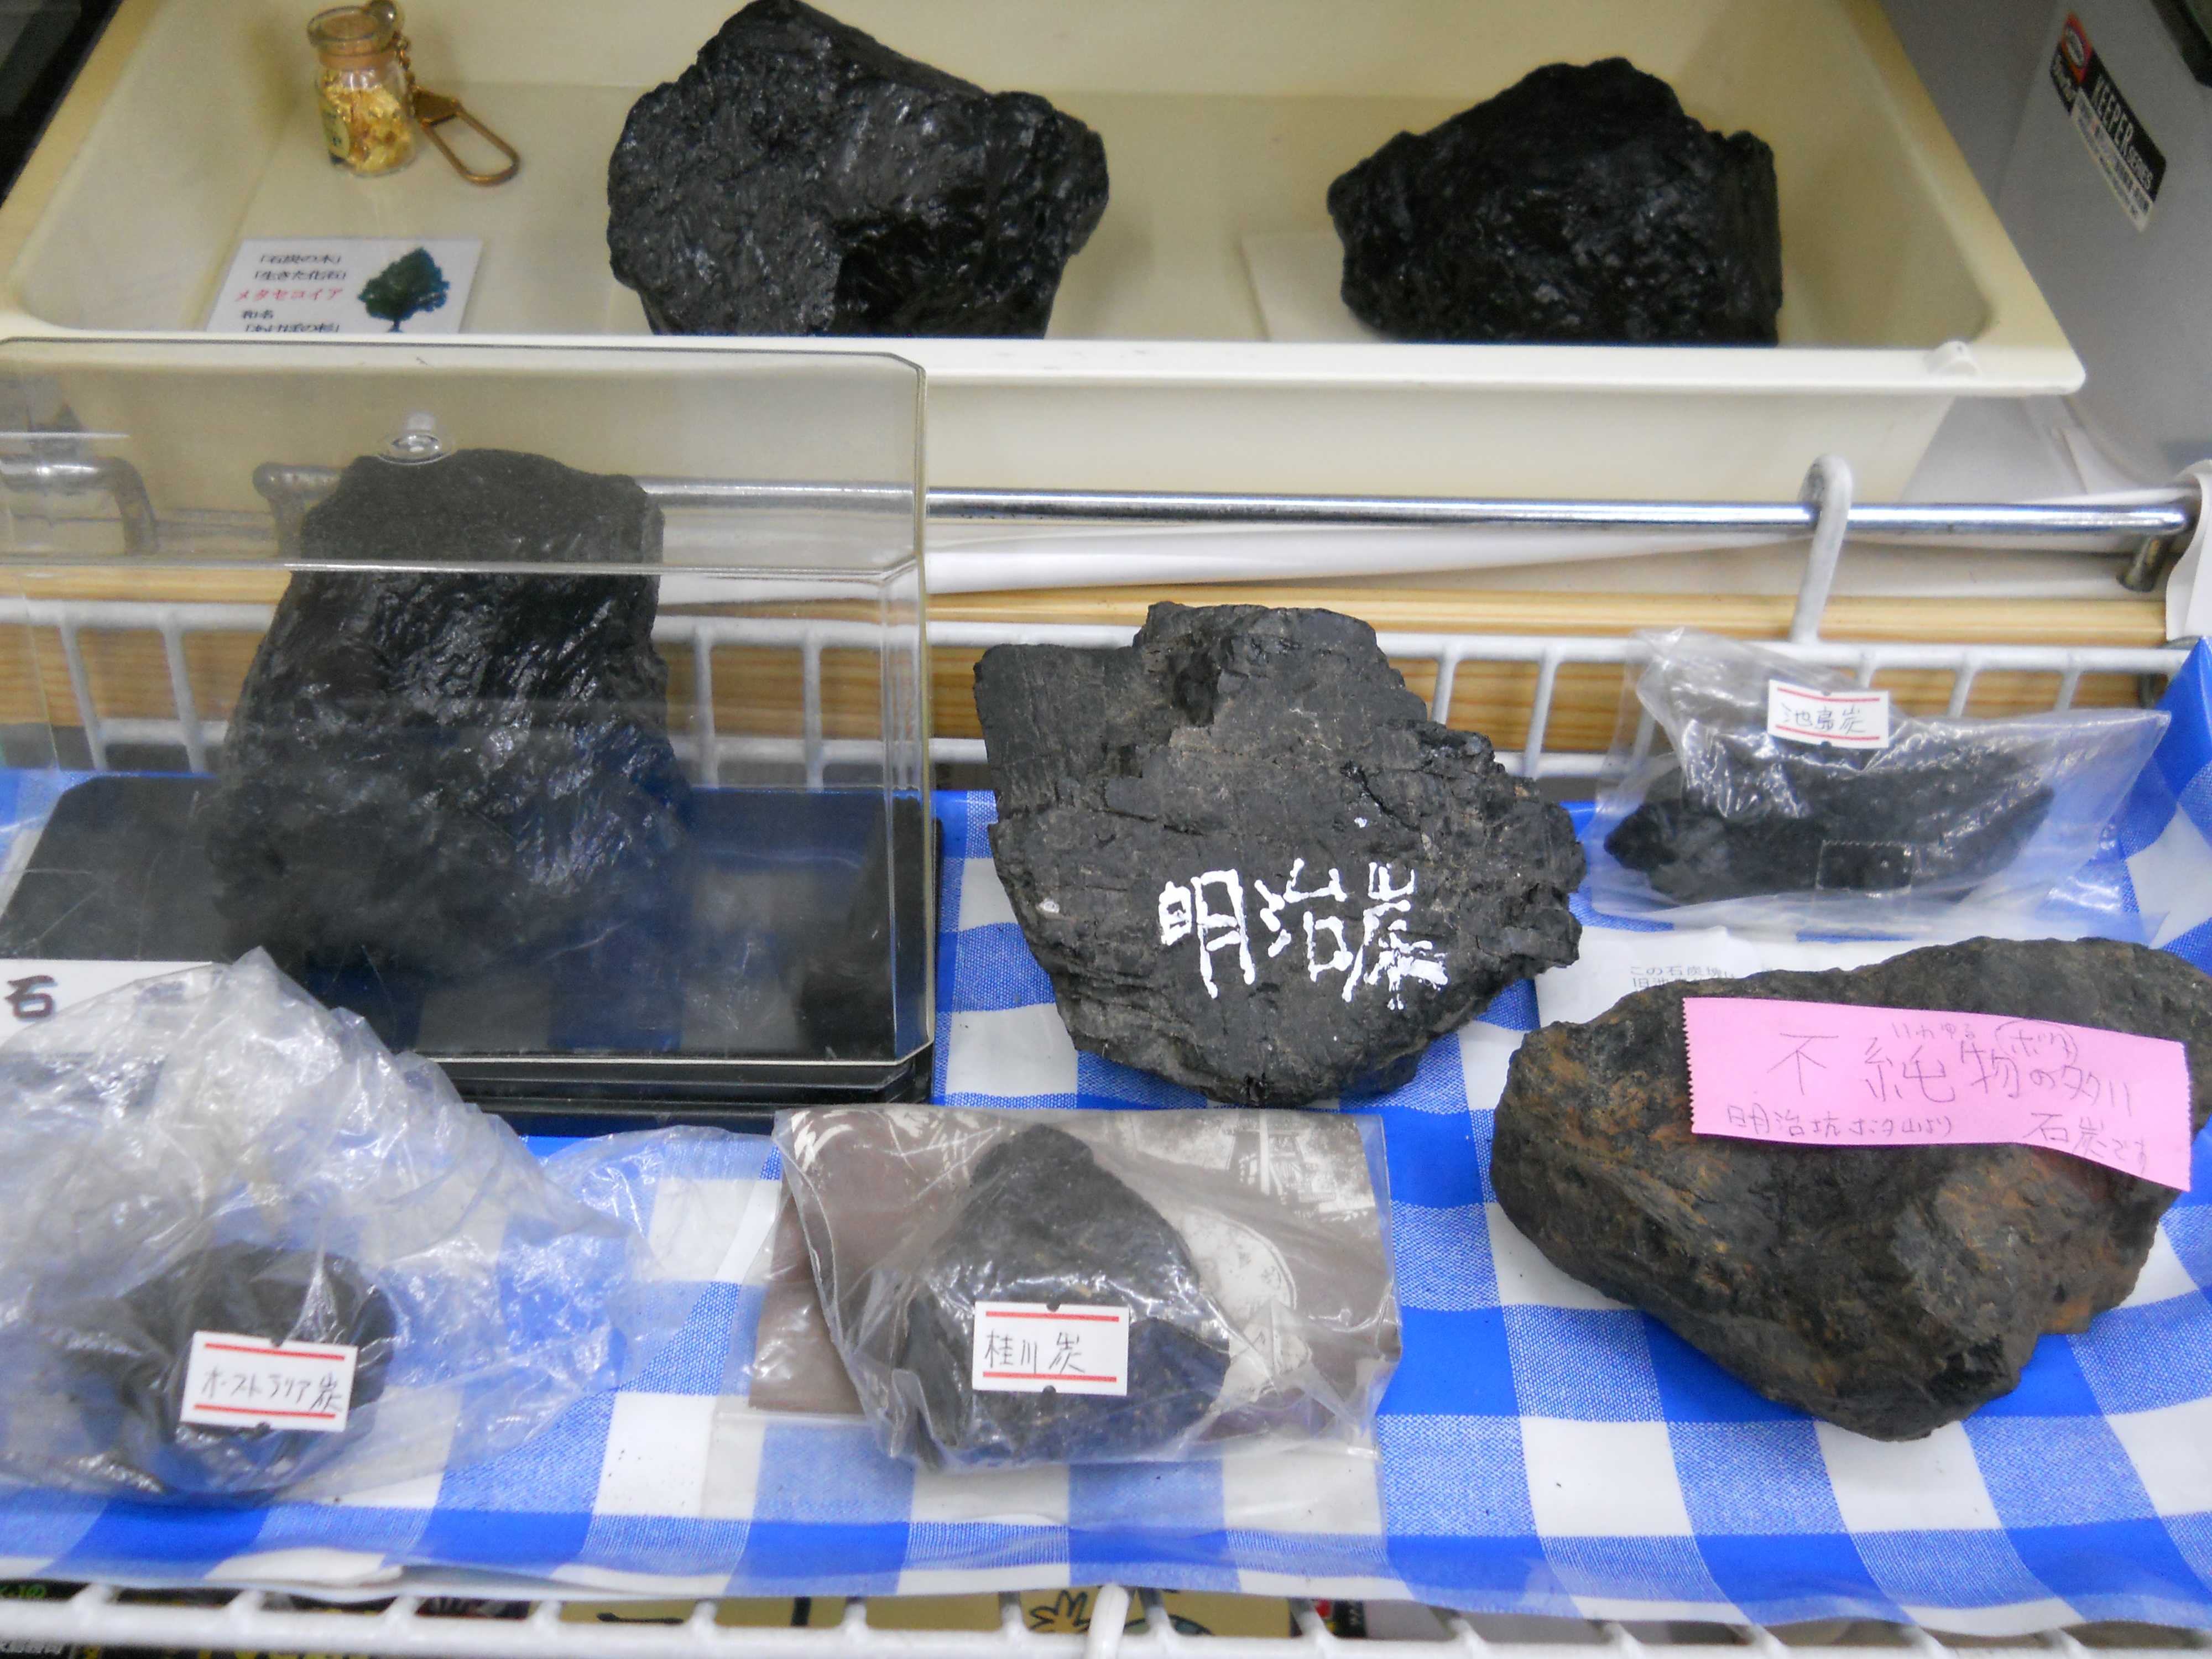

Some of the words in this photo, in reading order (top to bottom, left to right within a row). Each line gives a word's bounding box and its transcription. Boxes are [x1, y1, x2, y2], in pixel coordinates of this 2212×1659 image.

[2091, 75, 2134, 157] KEEPER
[235, 288, 343, 302] メタセコイア
[1781, 702, 1867, 734] 池島炭
[1159, 857, 1449, 1010] 明治炭
[4, 974, 58, 1020] 石
